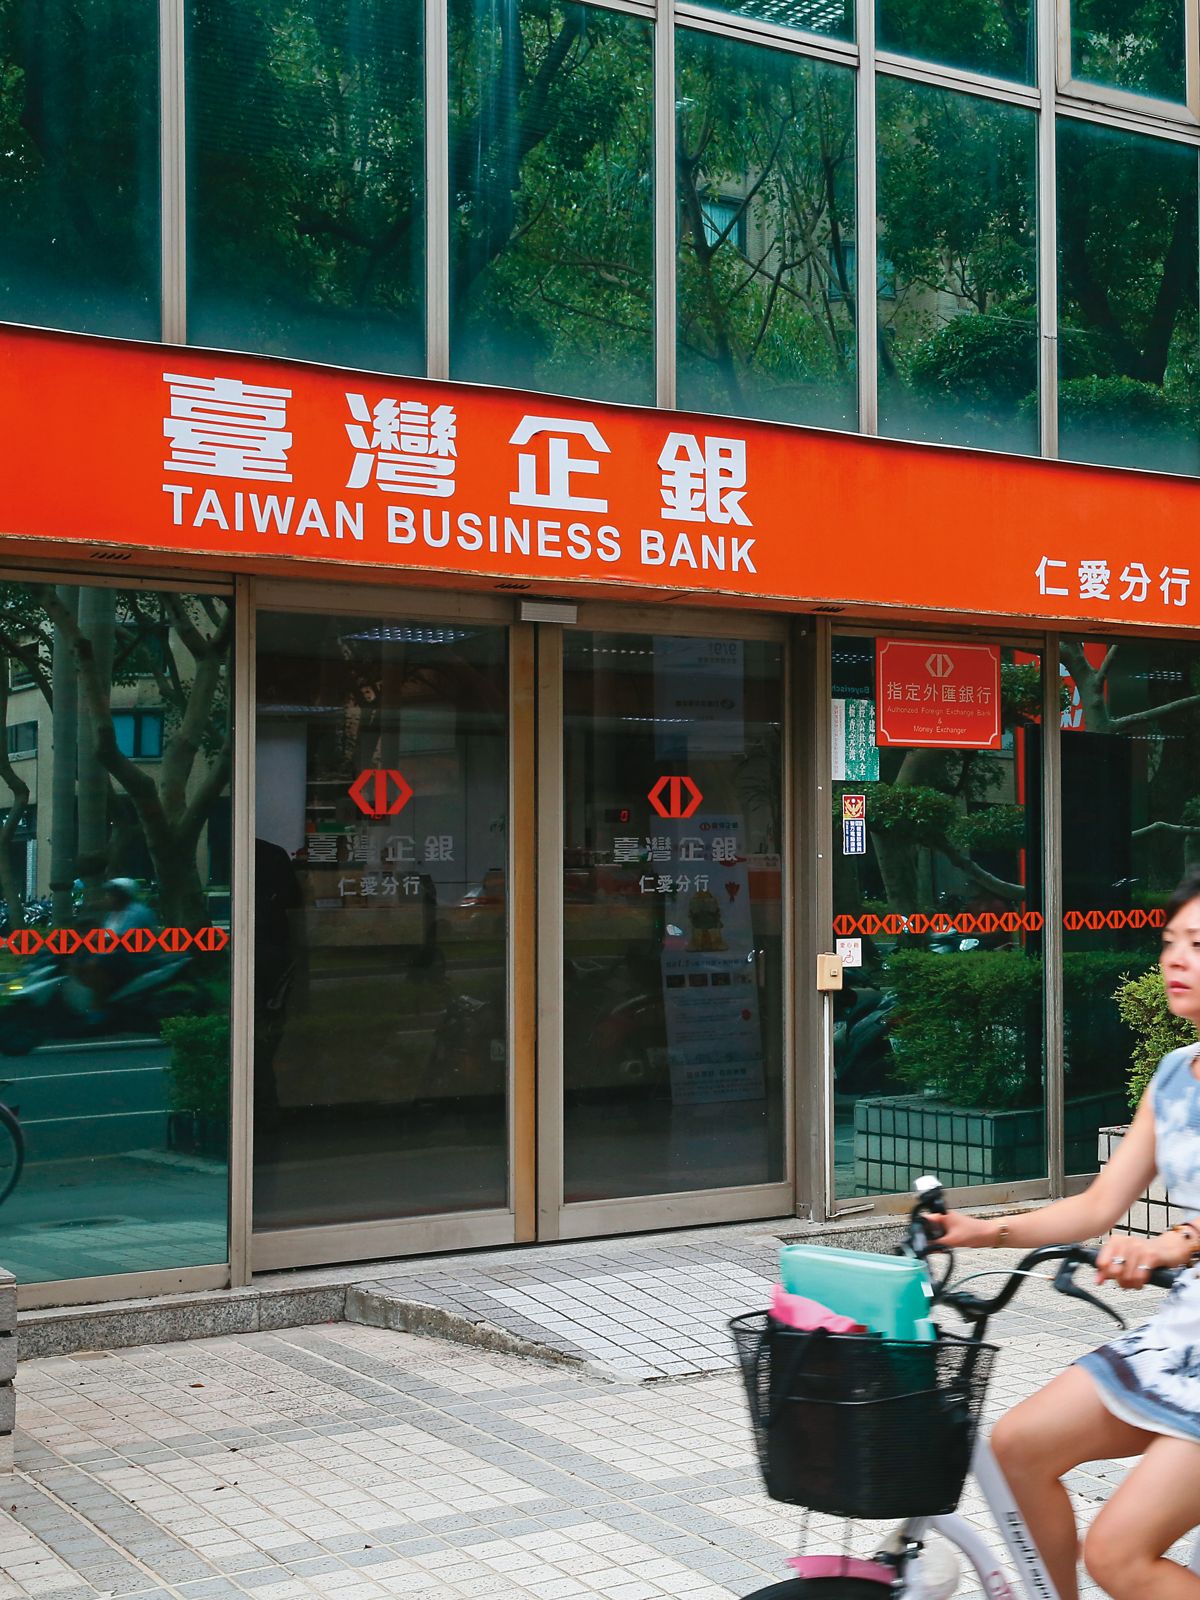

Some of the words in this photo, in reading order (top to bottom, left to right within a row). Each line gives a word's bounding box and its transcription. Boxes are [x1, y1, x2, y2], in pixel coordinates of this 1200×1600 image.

[162, 372, 753, 527] 臺灣企銀
[162, 484, 364, 541] TAIWAN
[387, 505, 621, 562] BUSINESS
[640, 529, 757, 574] BANK
[1035, 555, 1191, 606] 仁愛分行
[887, 681, 992, 705] 指定外匯銀行
[921, 707, 944, 717] Foreign
[946, 709, 974, 717] Exchange
[913, 726, 933, 734] Money
[936, 726, 967, 735] Exchanger
[613, 837, 739, 862] 臺灣企銀
[338, 876, 420, 896] 仁愛分行
[639, 874, 709, 893] 仁愛分行
